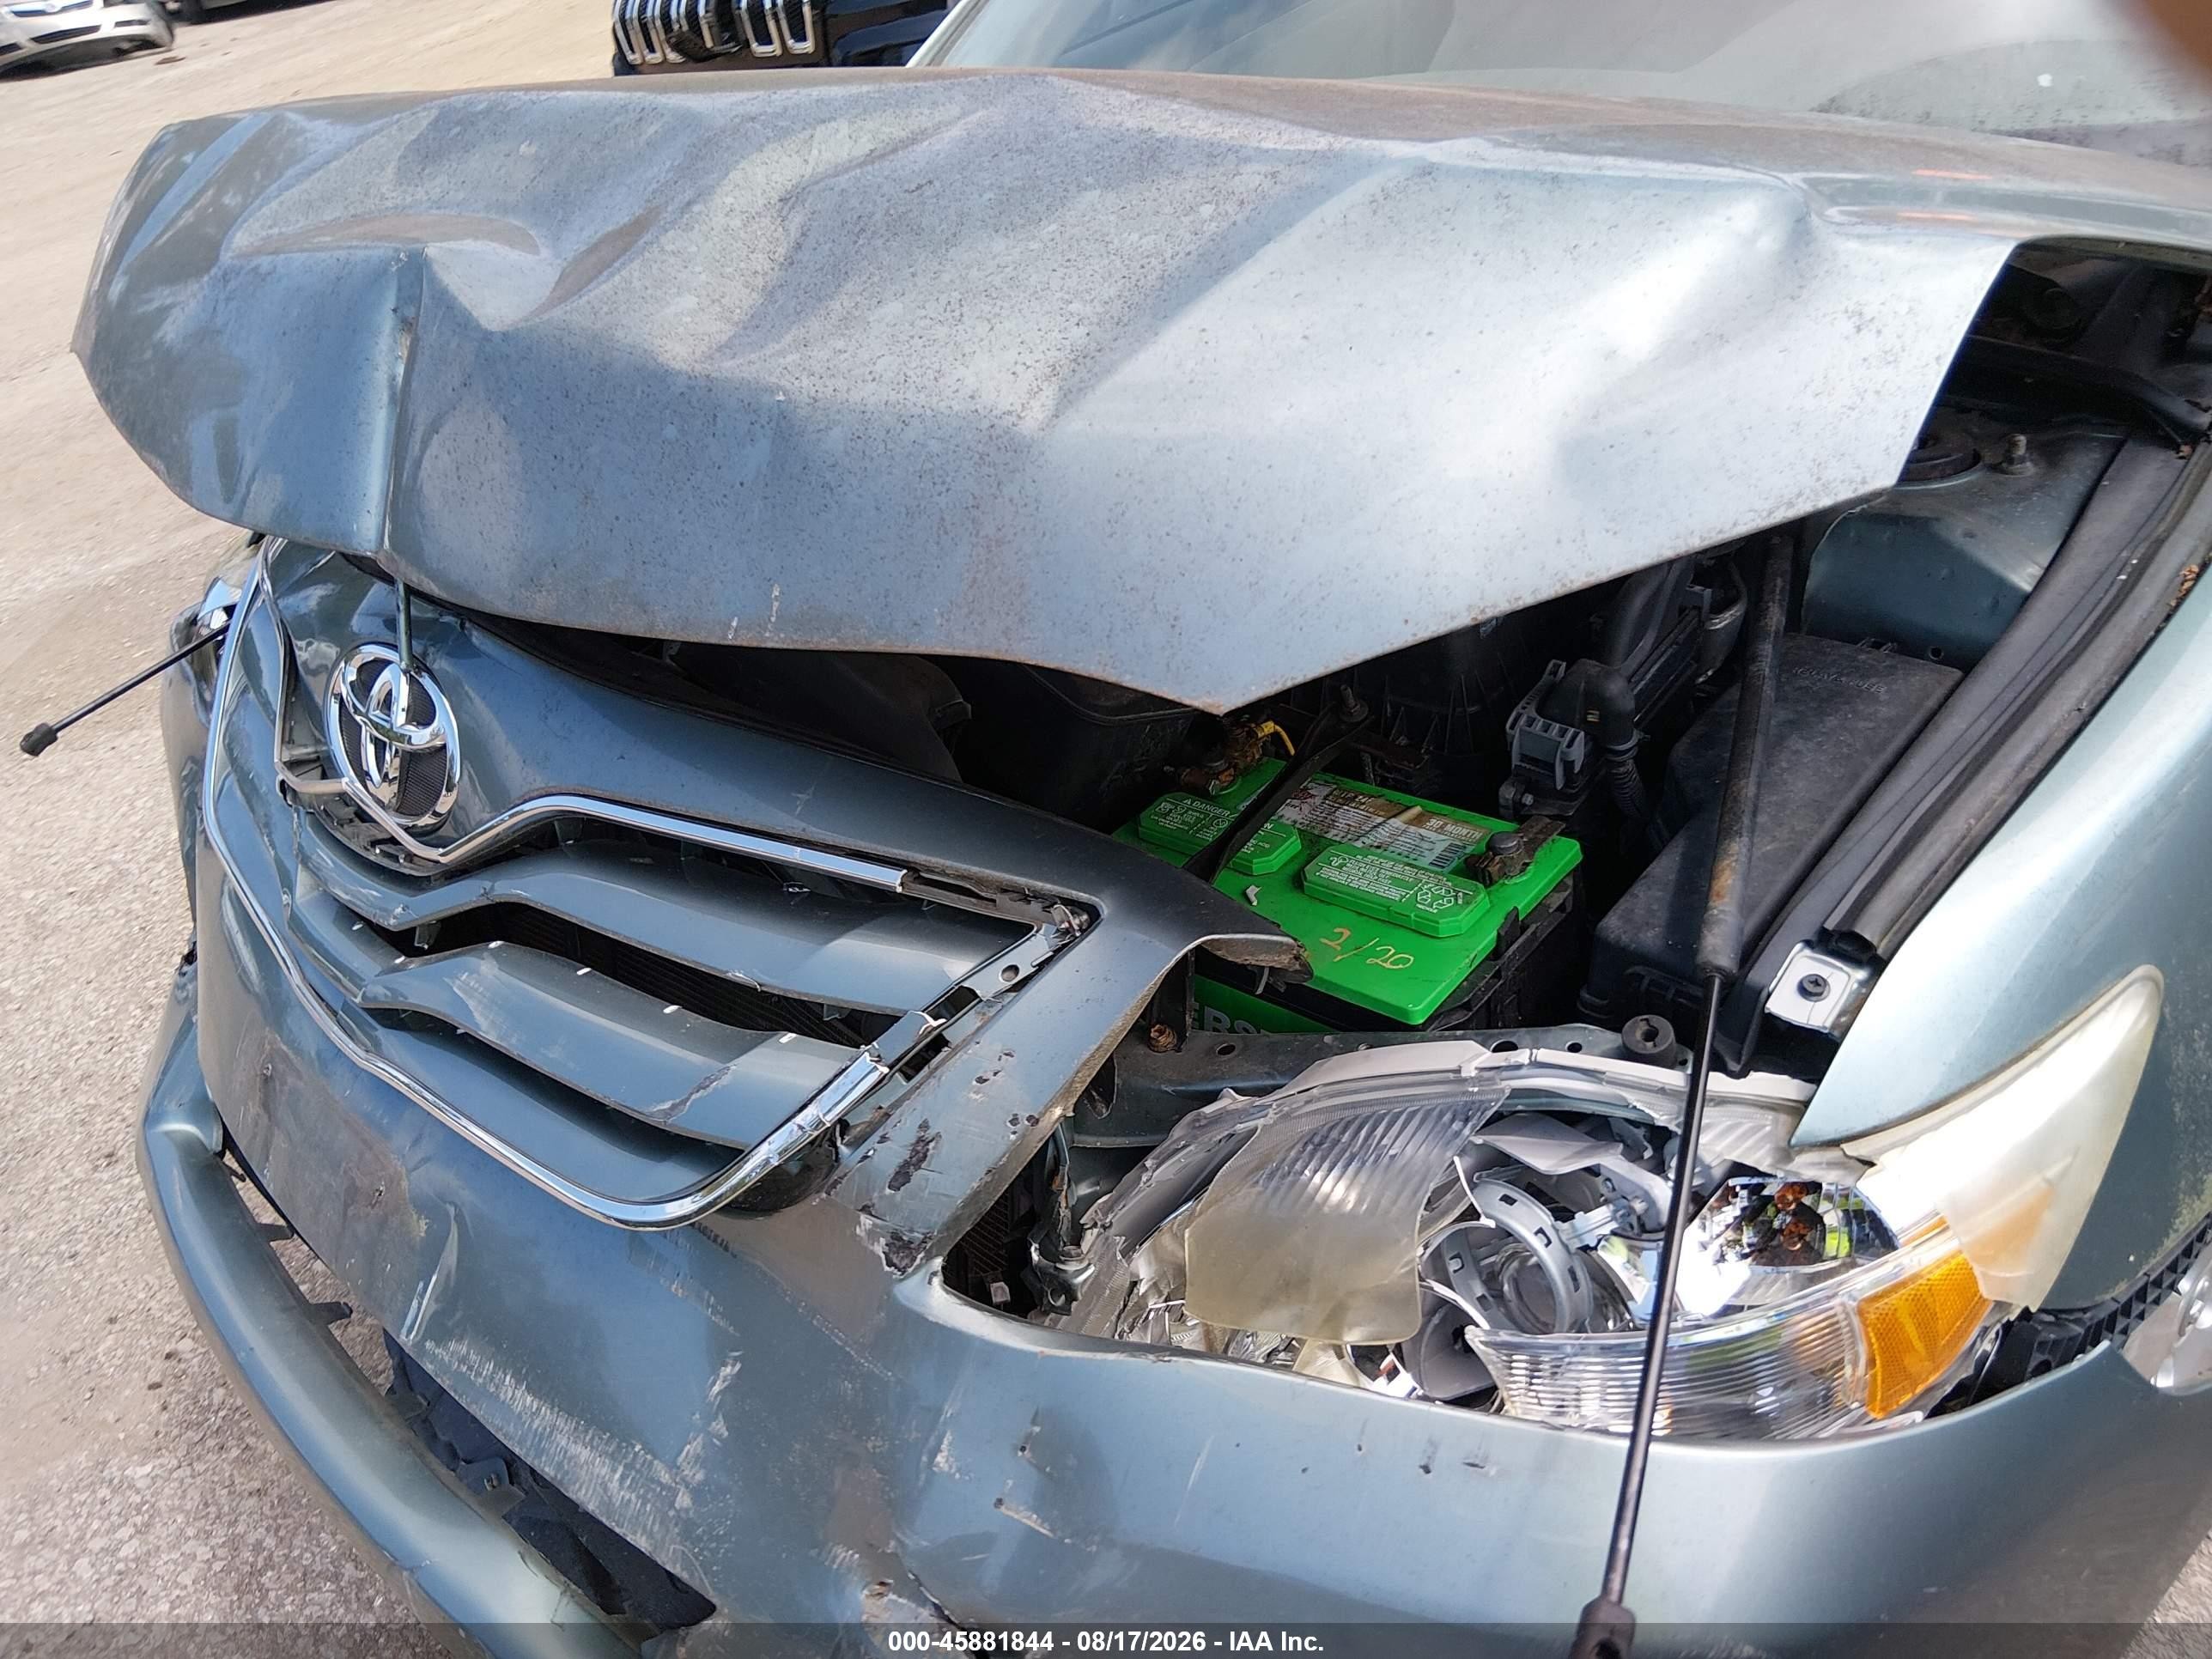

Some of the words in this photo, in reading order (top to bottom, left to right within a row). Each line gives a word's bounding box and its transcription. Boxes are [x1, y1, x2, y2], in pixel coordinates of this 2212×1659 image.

[1425, 817, 1443, 829] 30
[1443, 823, 1483, 838] MONTH
[1319, 927, 1414, 969] 2/20
